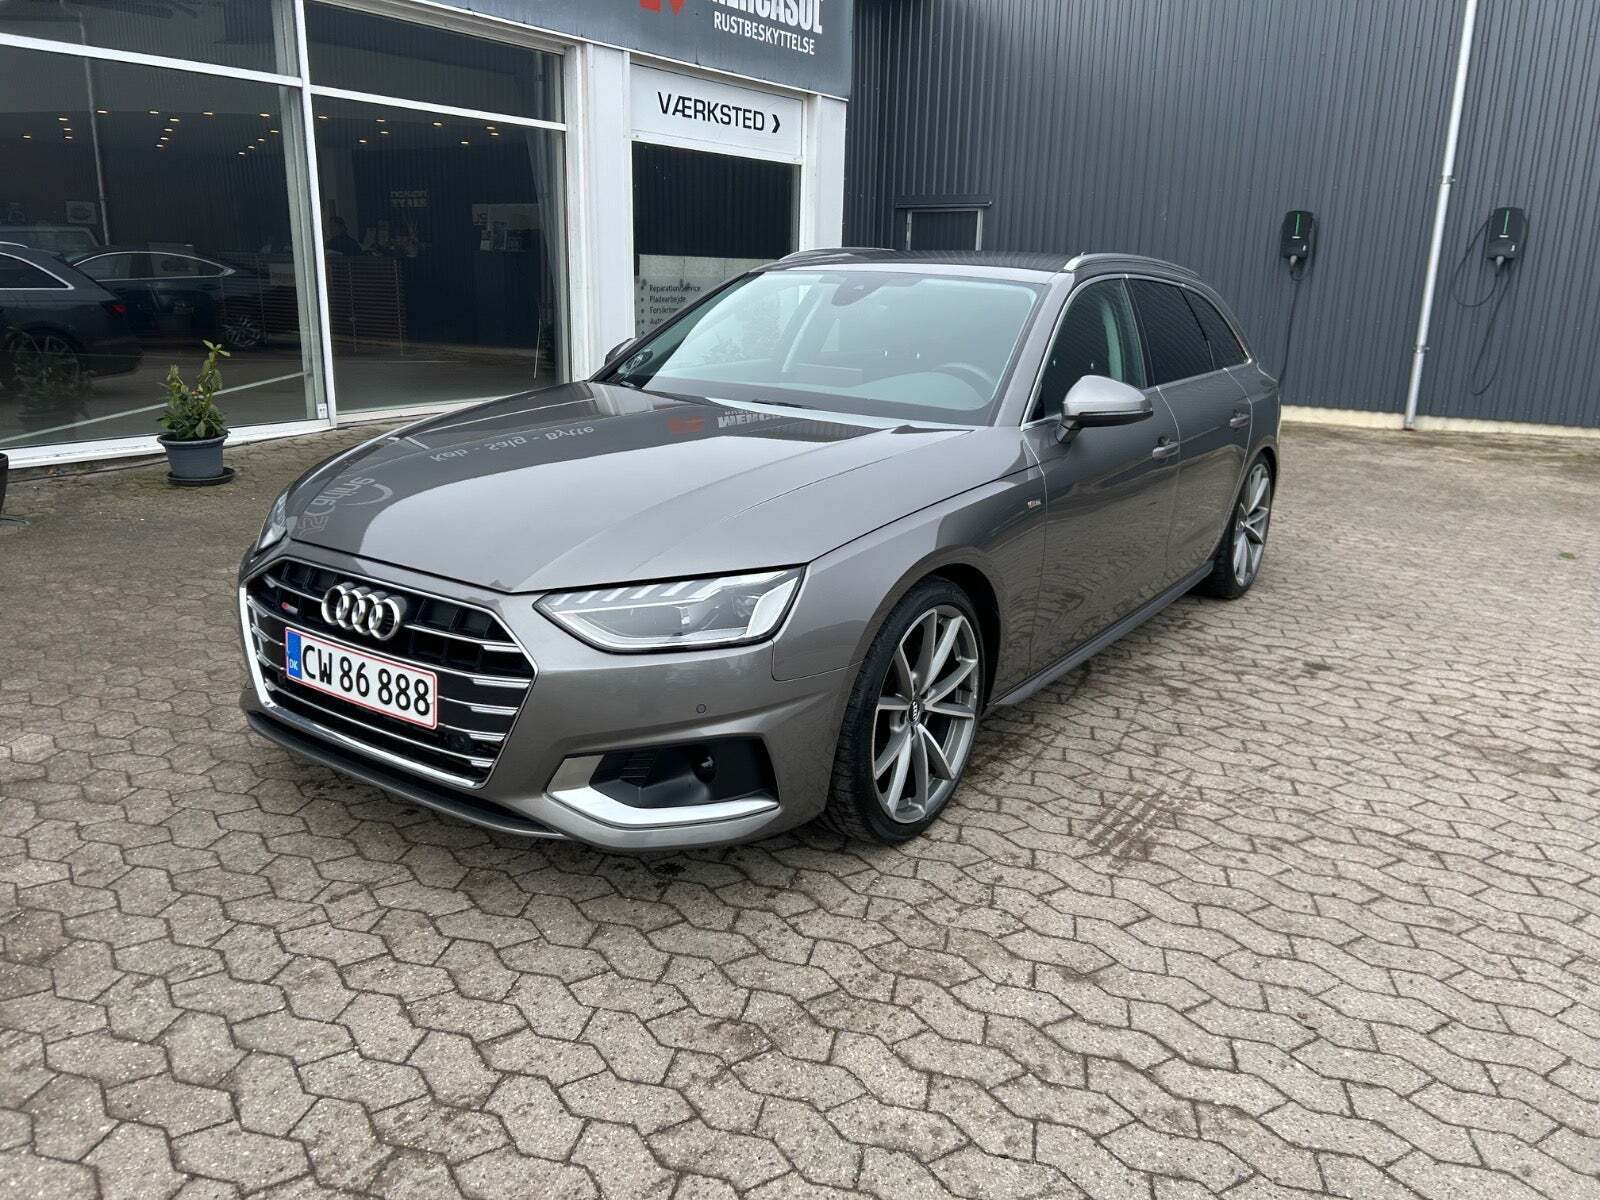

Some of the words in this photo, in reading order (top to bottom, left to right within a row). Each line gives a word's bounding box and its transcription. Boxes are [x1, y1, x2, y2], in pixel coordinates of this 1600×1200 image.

[713, 11, 815, 55] RUSTBESKYTTELSE
[657, 91, 765, 131] VÆRKSTED
[289, 660, 298, 670] DK
[302, 645, 333, 685] CW
[339, 656, 370, 698] 86
[377, 668, 430, 716] 888
